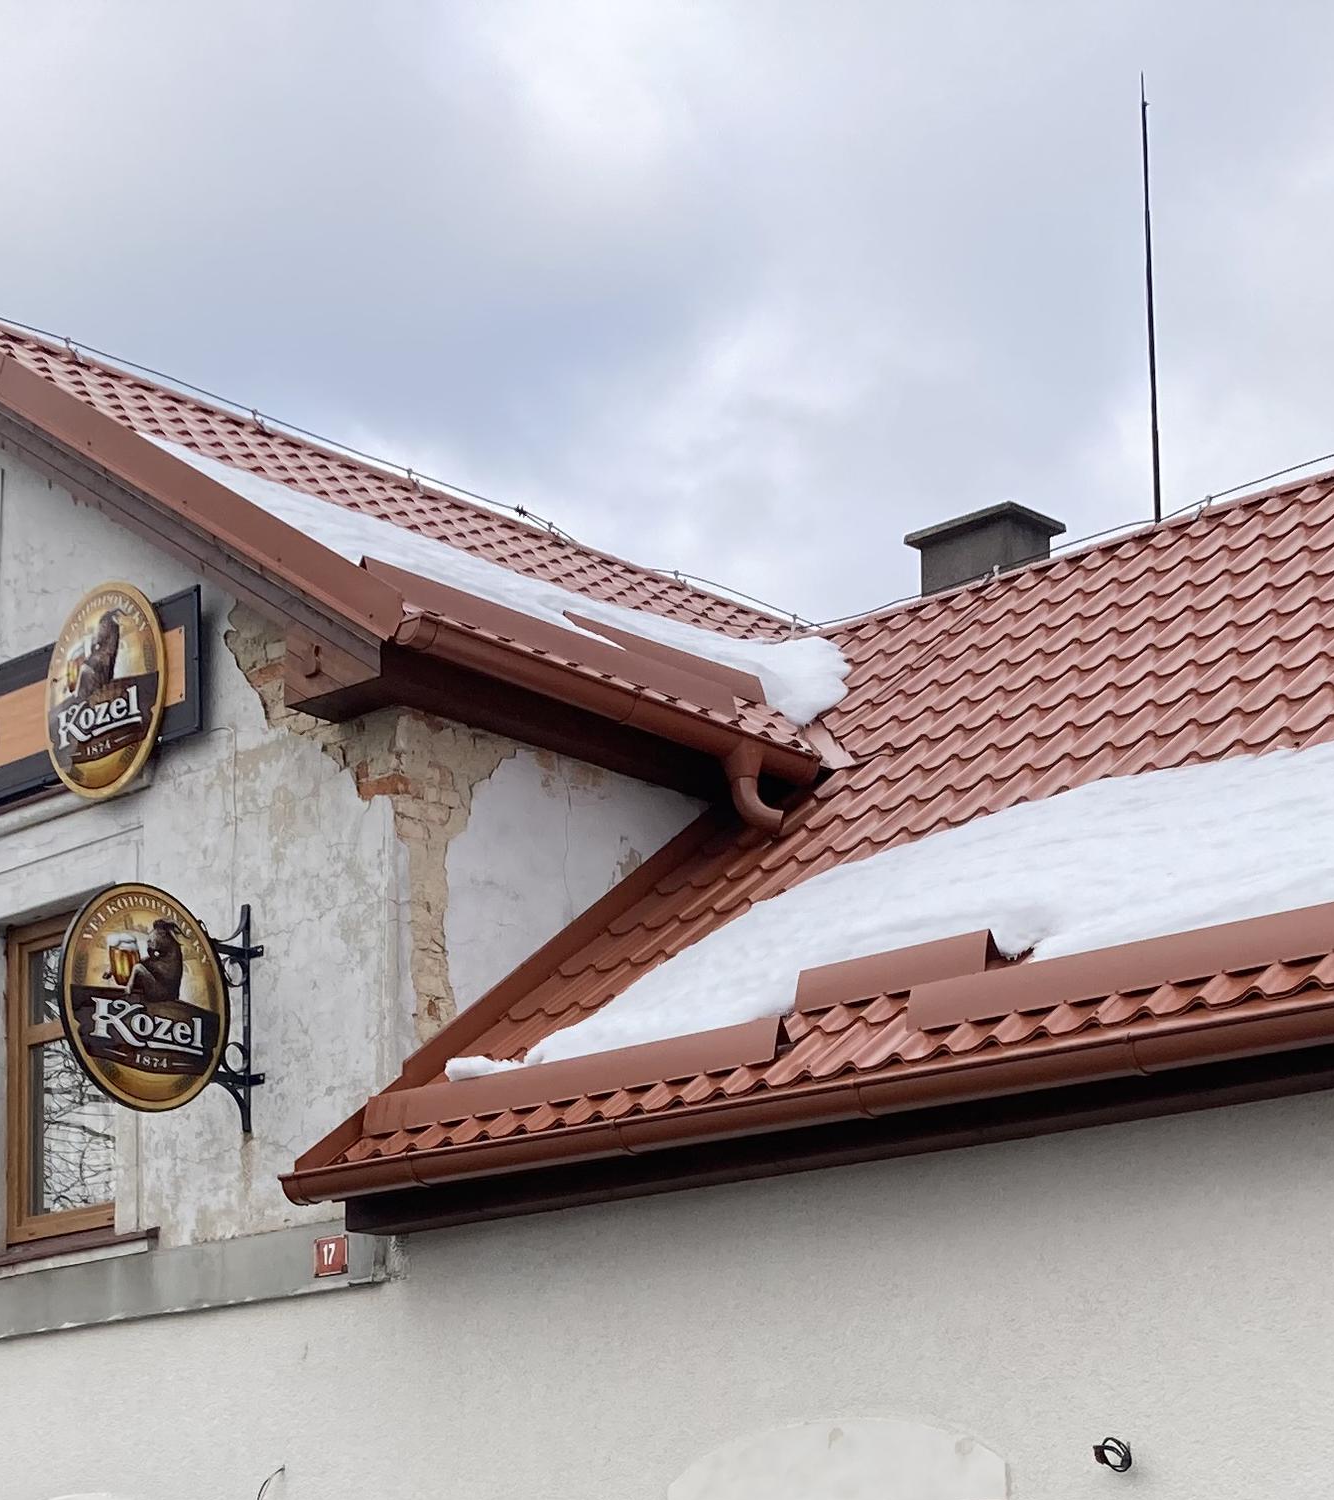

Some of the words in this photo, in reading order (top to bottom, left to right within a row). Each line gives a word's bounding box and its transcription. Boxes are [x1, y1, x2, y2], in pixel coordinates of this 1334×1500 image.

[57, 685, 142, 749] Kozel
[87, 740, 113, 757] 1874
[91, 996, 204, 1052] Kozel
[135, 1054, 168, 1068] 1874
[323, 1243, 336, 1266] 17
